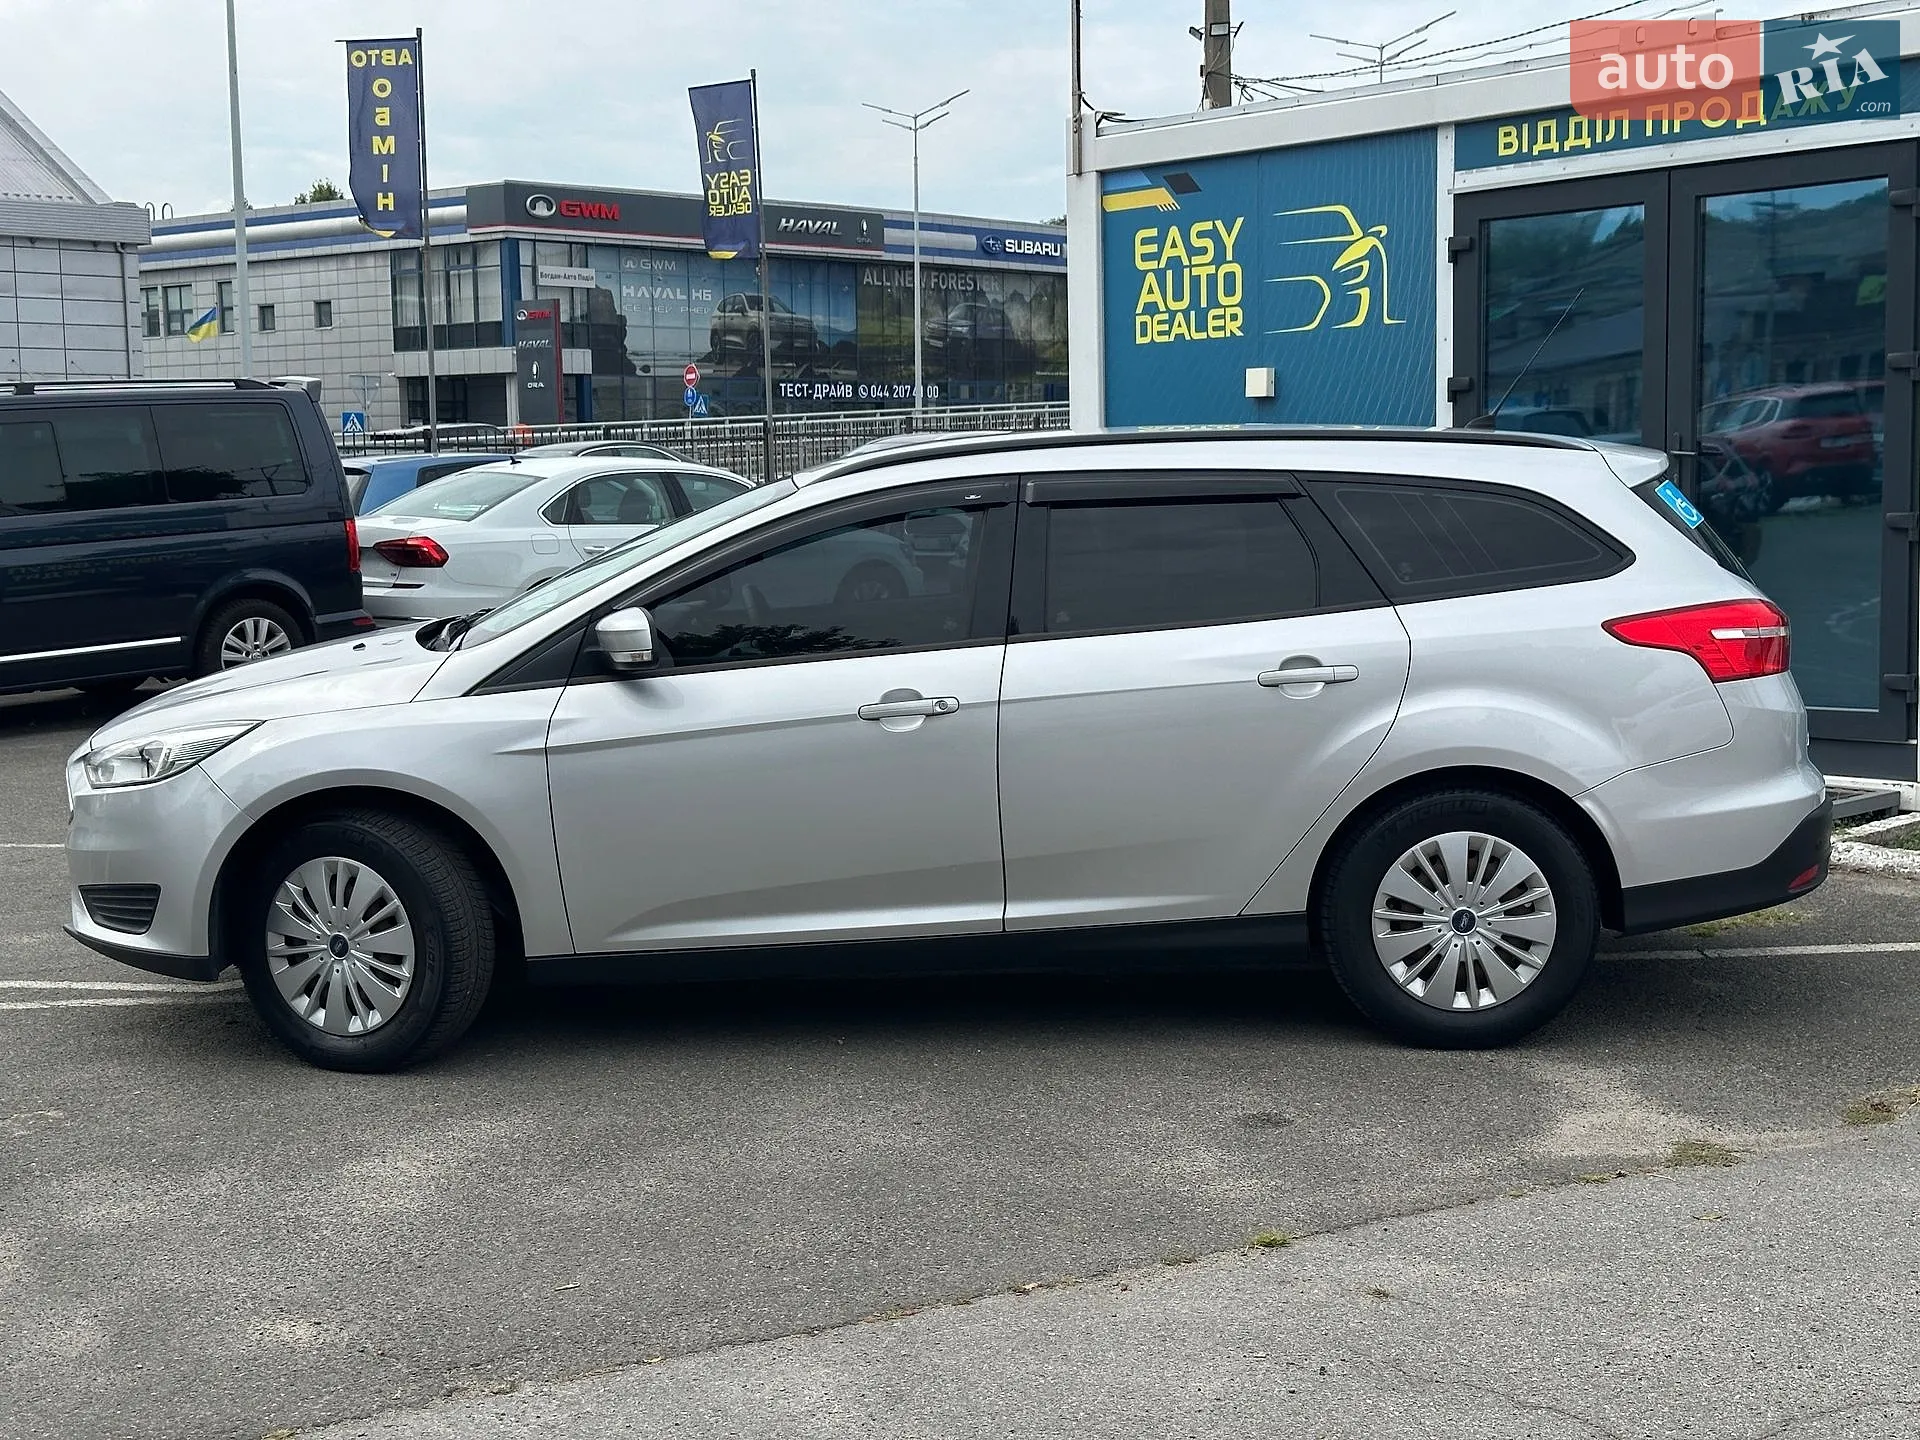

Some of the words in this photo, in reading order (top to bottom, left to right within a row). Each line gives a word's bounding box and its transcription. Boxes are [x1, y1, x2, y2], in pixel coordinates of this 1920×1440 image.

[1498, 108, 1630, 157] ВІДДІЛ
[559, 200, 620, 220] GWM
[777, 218, 842, 236] HAVAL
[1005, 239, 1060, 256] SUBARU
[1134, 217, 1244, 270] EASY
[640, 259, 676, 271] GWM
[863, 268, 891, 286] ALL
[622, 285, 687, 300] HAVAL
[1136, 263, 1243, 313] AUTO
[1136, 306, 1244, 344] DEALER
[519, 339, 552, 348] HAVAL
[779, 382, 852, 399] ТЕСТ-ДРАЙВ
[871, 384, 889, 398] 044
[893, 385, 911, 398] 207
[927, 385, 939, 398] 00
